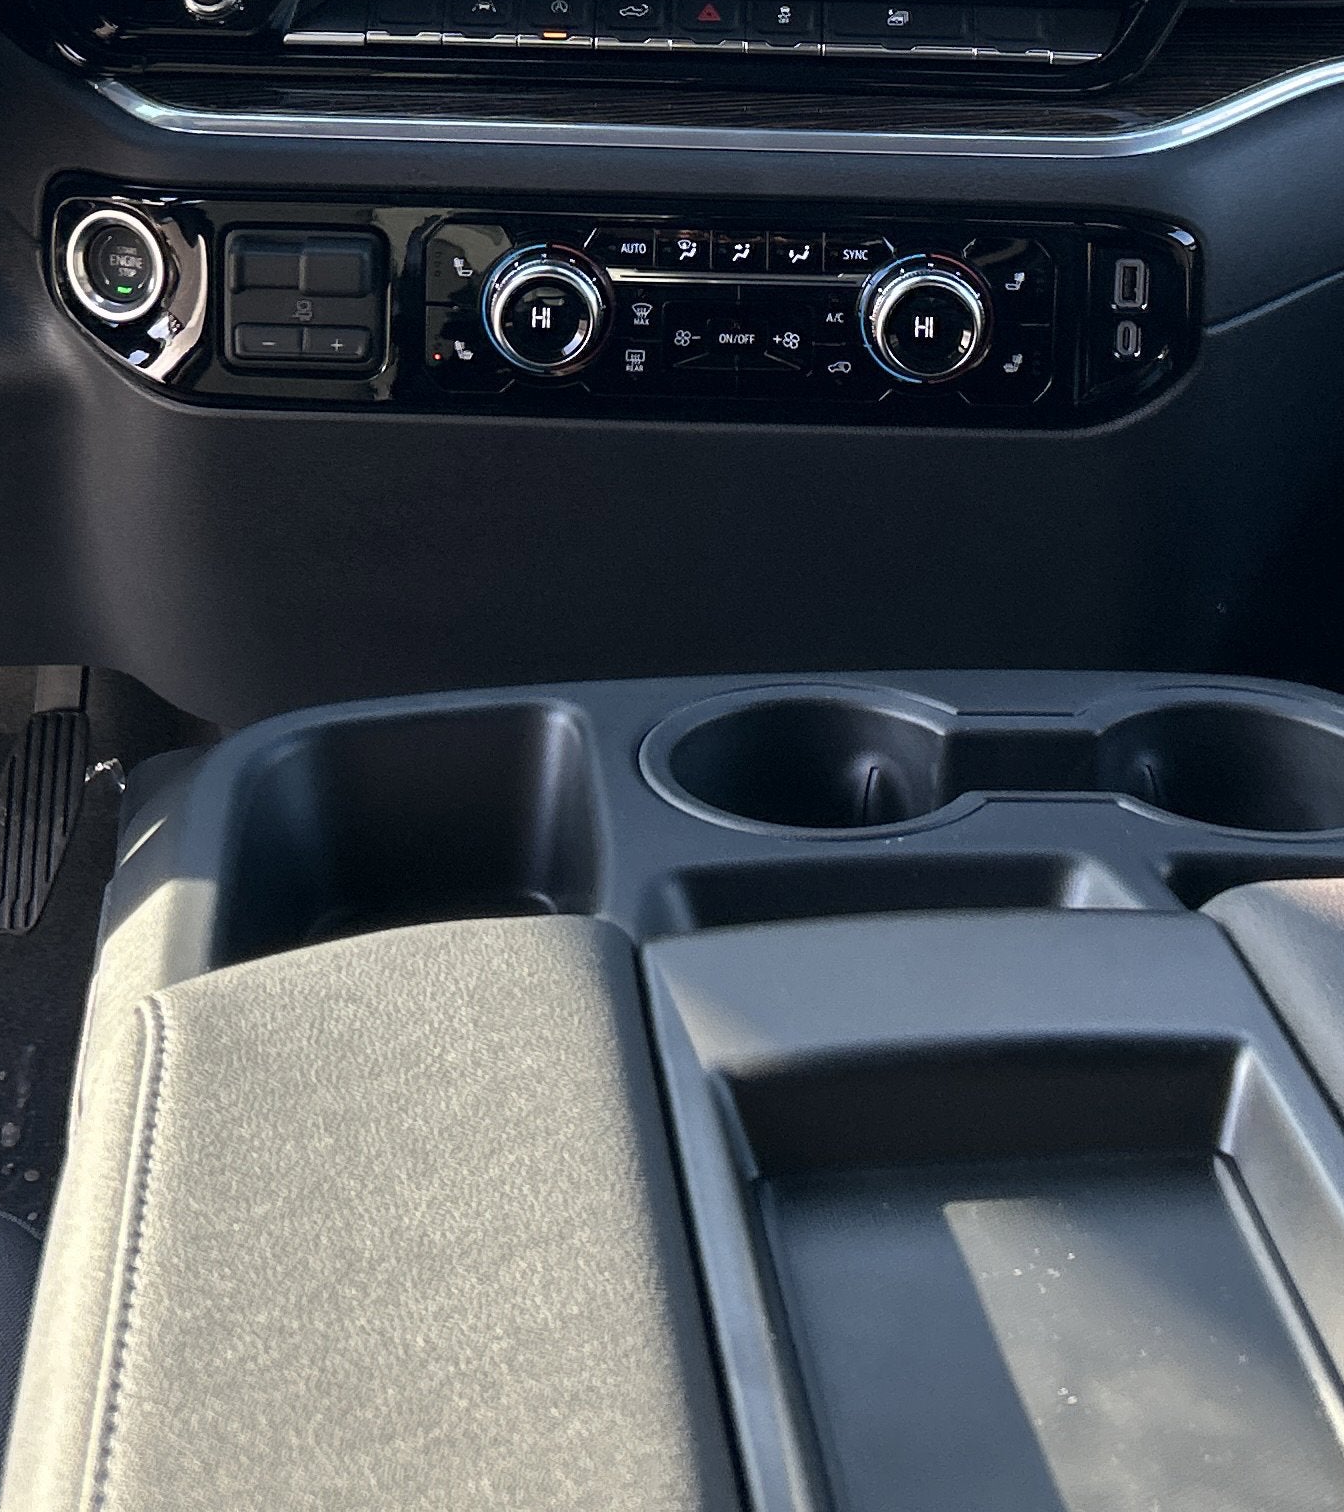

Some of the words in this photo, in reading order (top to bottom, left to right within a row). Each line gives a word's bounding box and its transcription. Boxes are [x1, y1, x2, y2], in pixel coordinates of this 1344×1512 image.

[621, 243, 646, 254] AUTO
[843, 249, 868, 261] SYNC
[531, 307, 551, 329] HI
[826, 313, 844, 323] A/C
[914, 316, 934, 338] HI
[719, 334, 755, 344] ON/OFF
